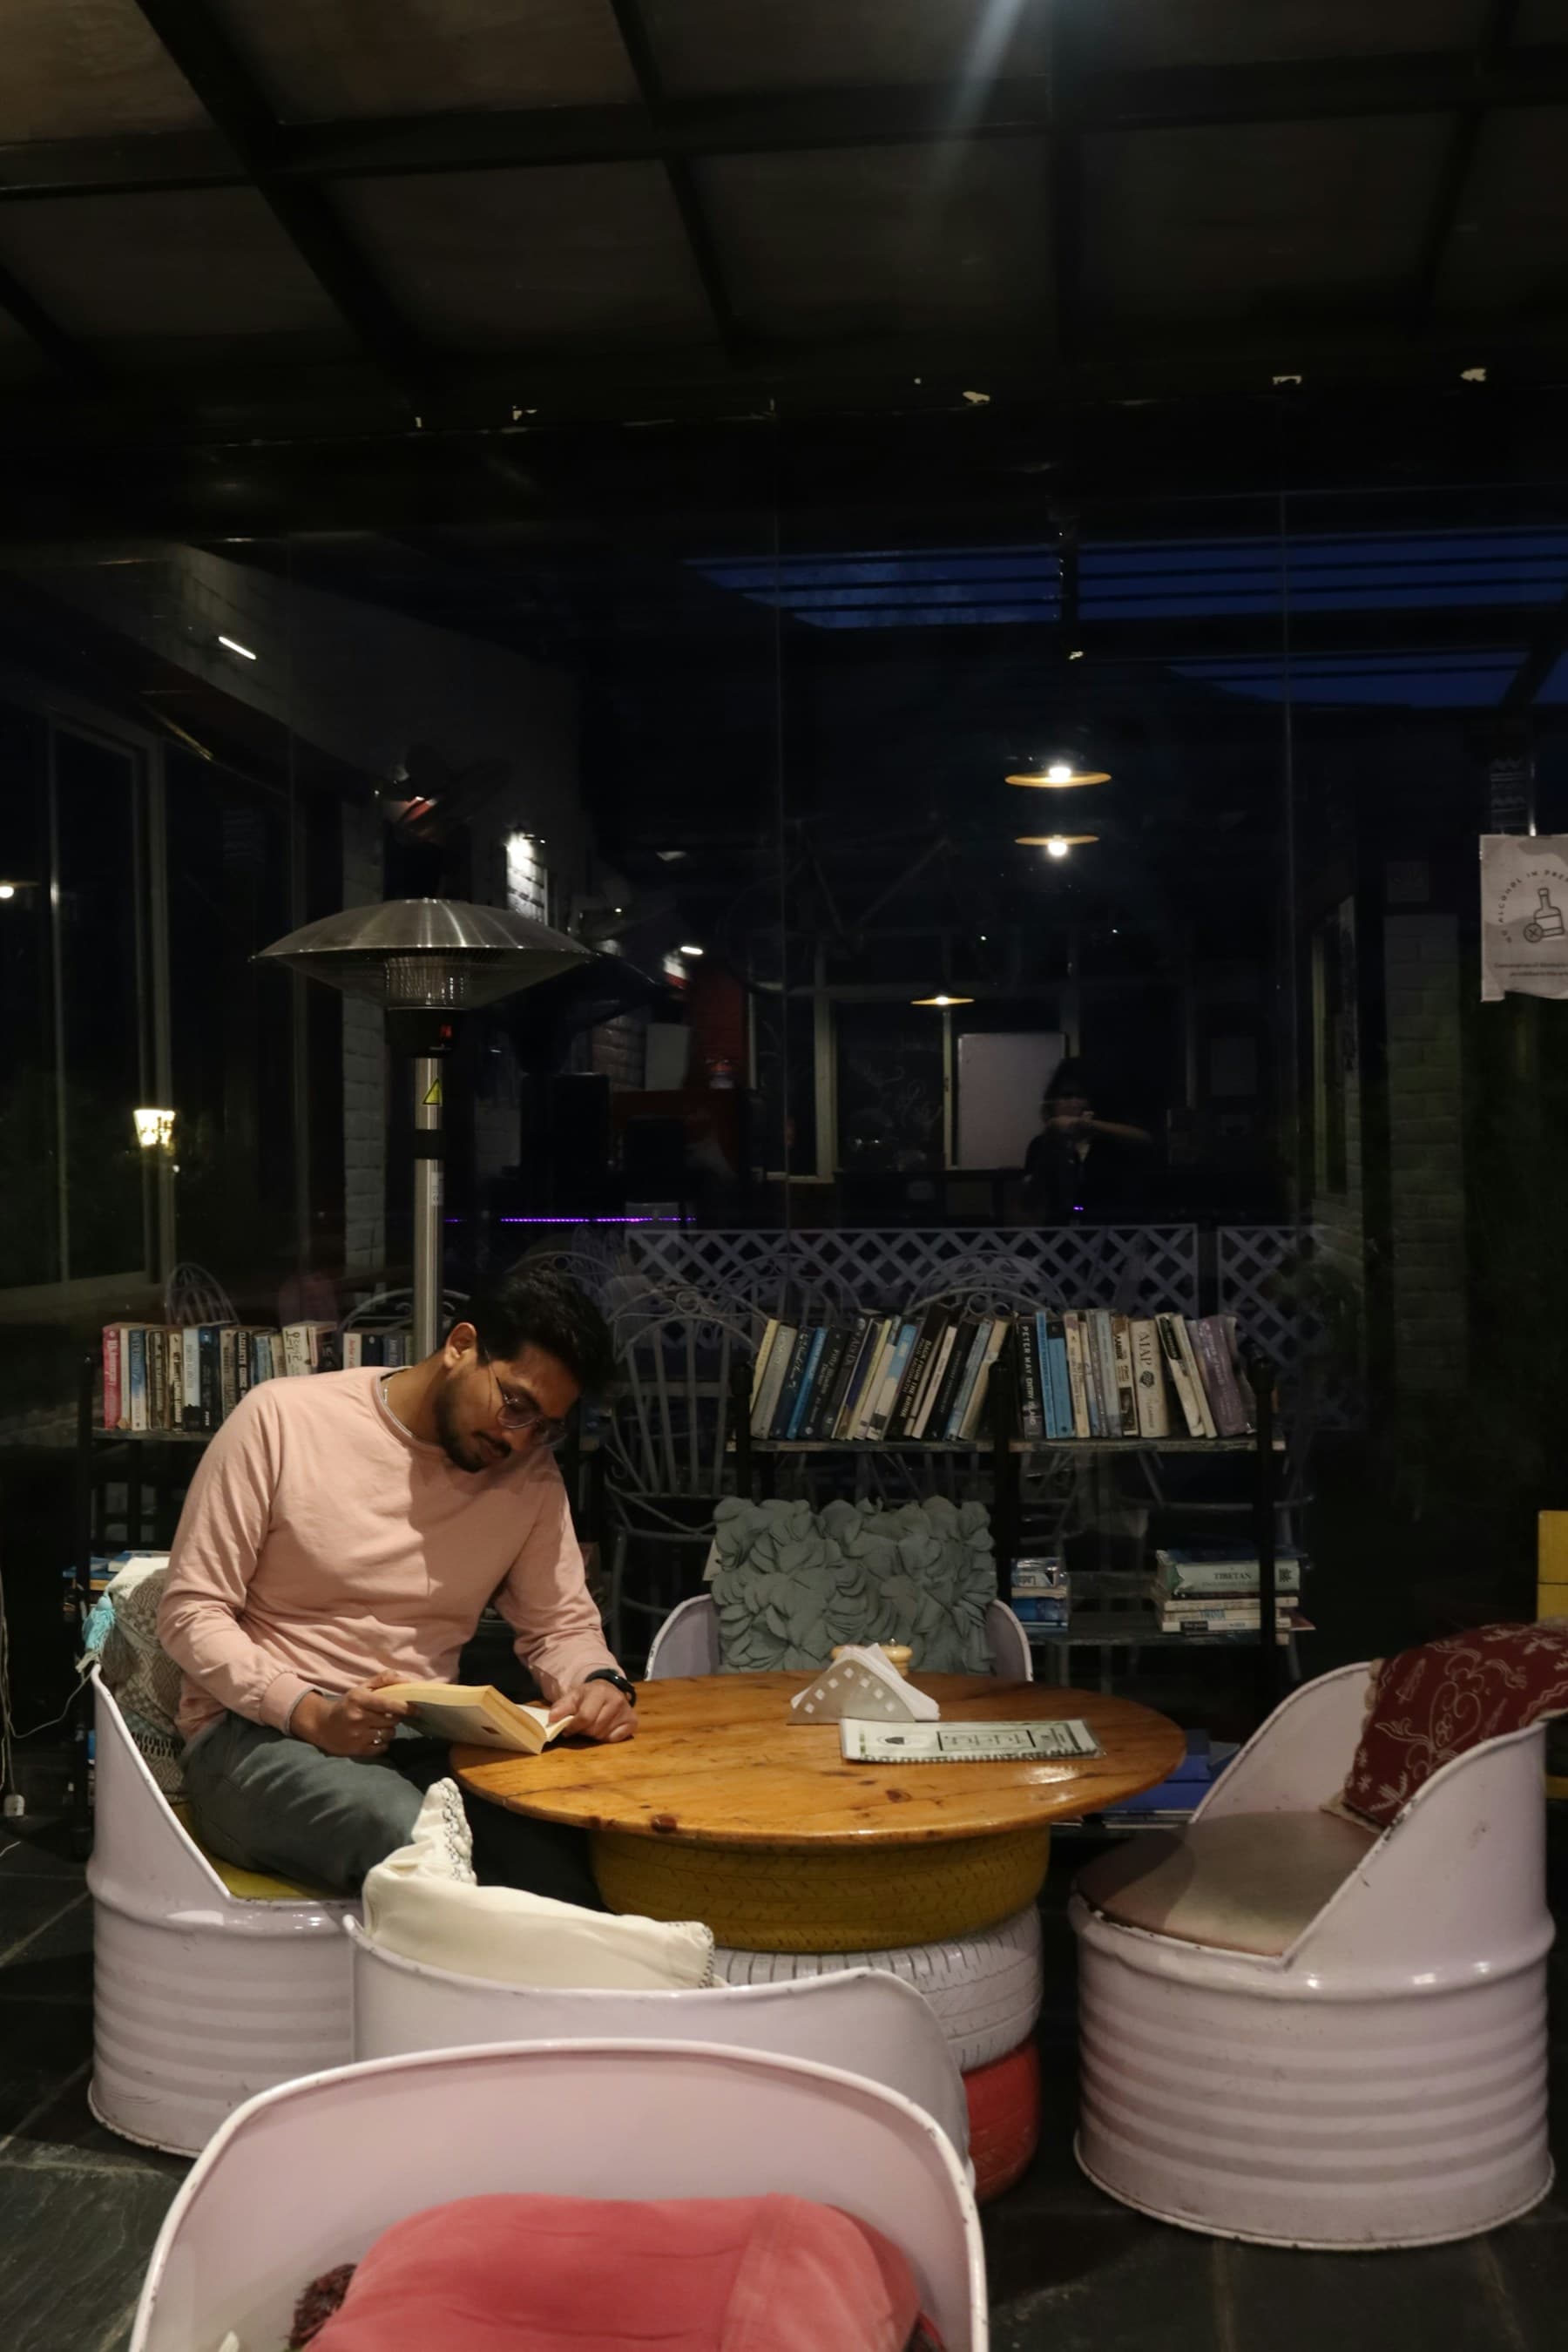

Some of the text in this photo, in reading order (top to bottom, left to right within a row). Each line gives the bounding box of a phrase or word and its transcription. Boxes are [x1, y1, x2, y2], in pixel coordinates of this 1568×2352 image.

[1498, 878, 1522, 923] ALCOHOL
[1021, 1325, 1032, 1374] PETER MAY
[899, 1339, 932, 1418] BACK FROM THE BRINK
[1025, 1376, 1034, 1398] ENTRY
